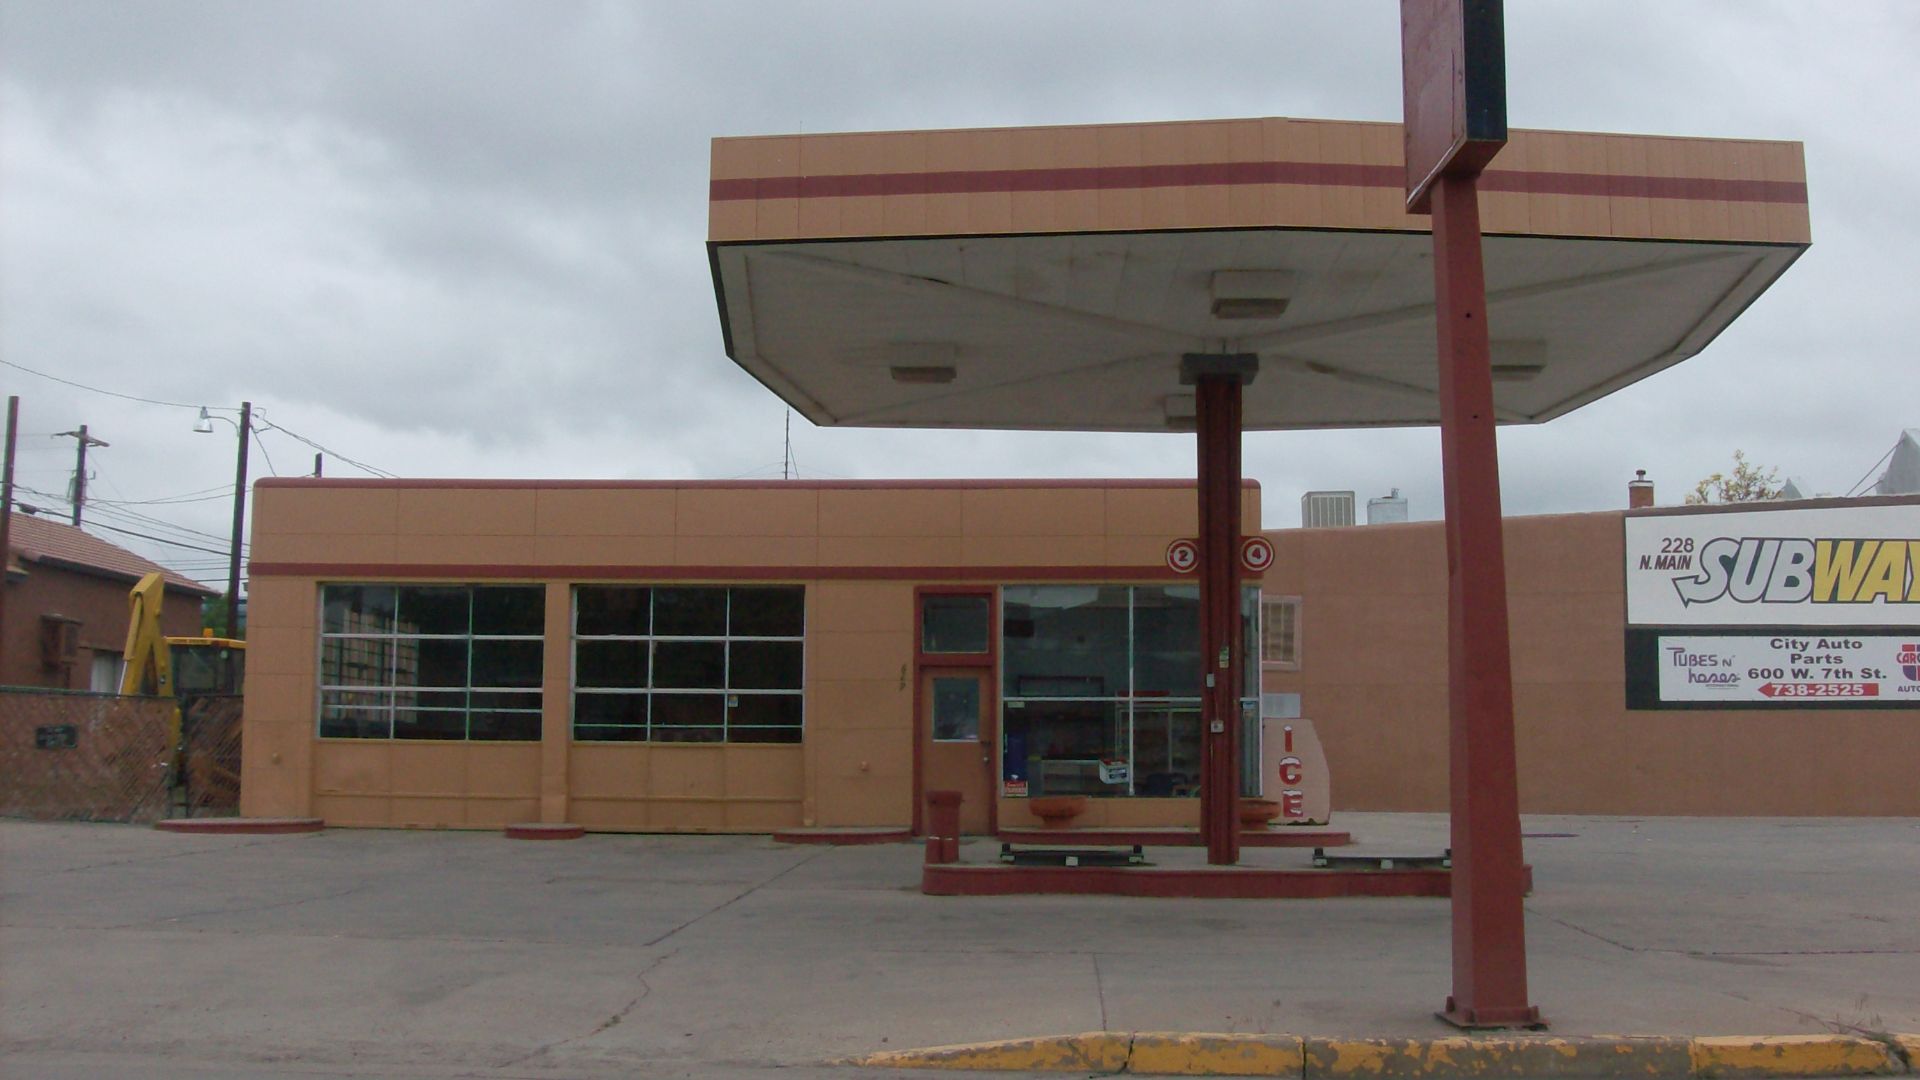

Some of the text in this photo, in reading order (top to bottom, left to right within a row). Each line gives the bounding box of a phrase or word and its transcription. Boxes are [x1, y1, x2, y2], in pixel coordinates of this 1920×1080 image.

[1661, 537, 1694, 553] 228
[1178, 549, 1189, 562] 2
[1252, 547, 1262, 560] 4
[1654, 555, 1692, 570] MAIN
[1770, 638, 1863, 652] City Auto
[1790, 653, 1844, 665] Parts
[1748, 668, 1887, 680] 600 W. 7th St.
[1772, 683, 1865, 697] 738-2525
[1279, 725, 1303, 818] ICE
